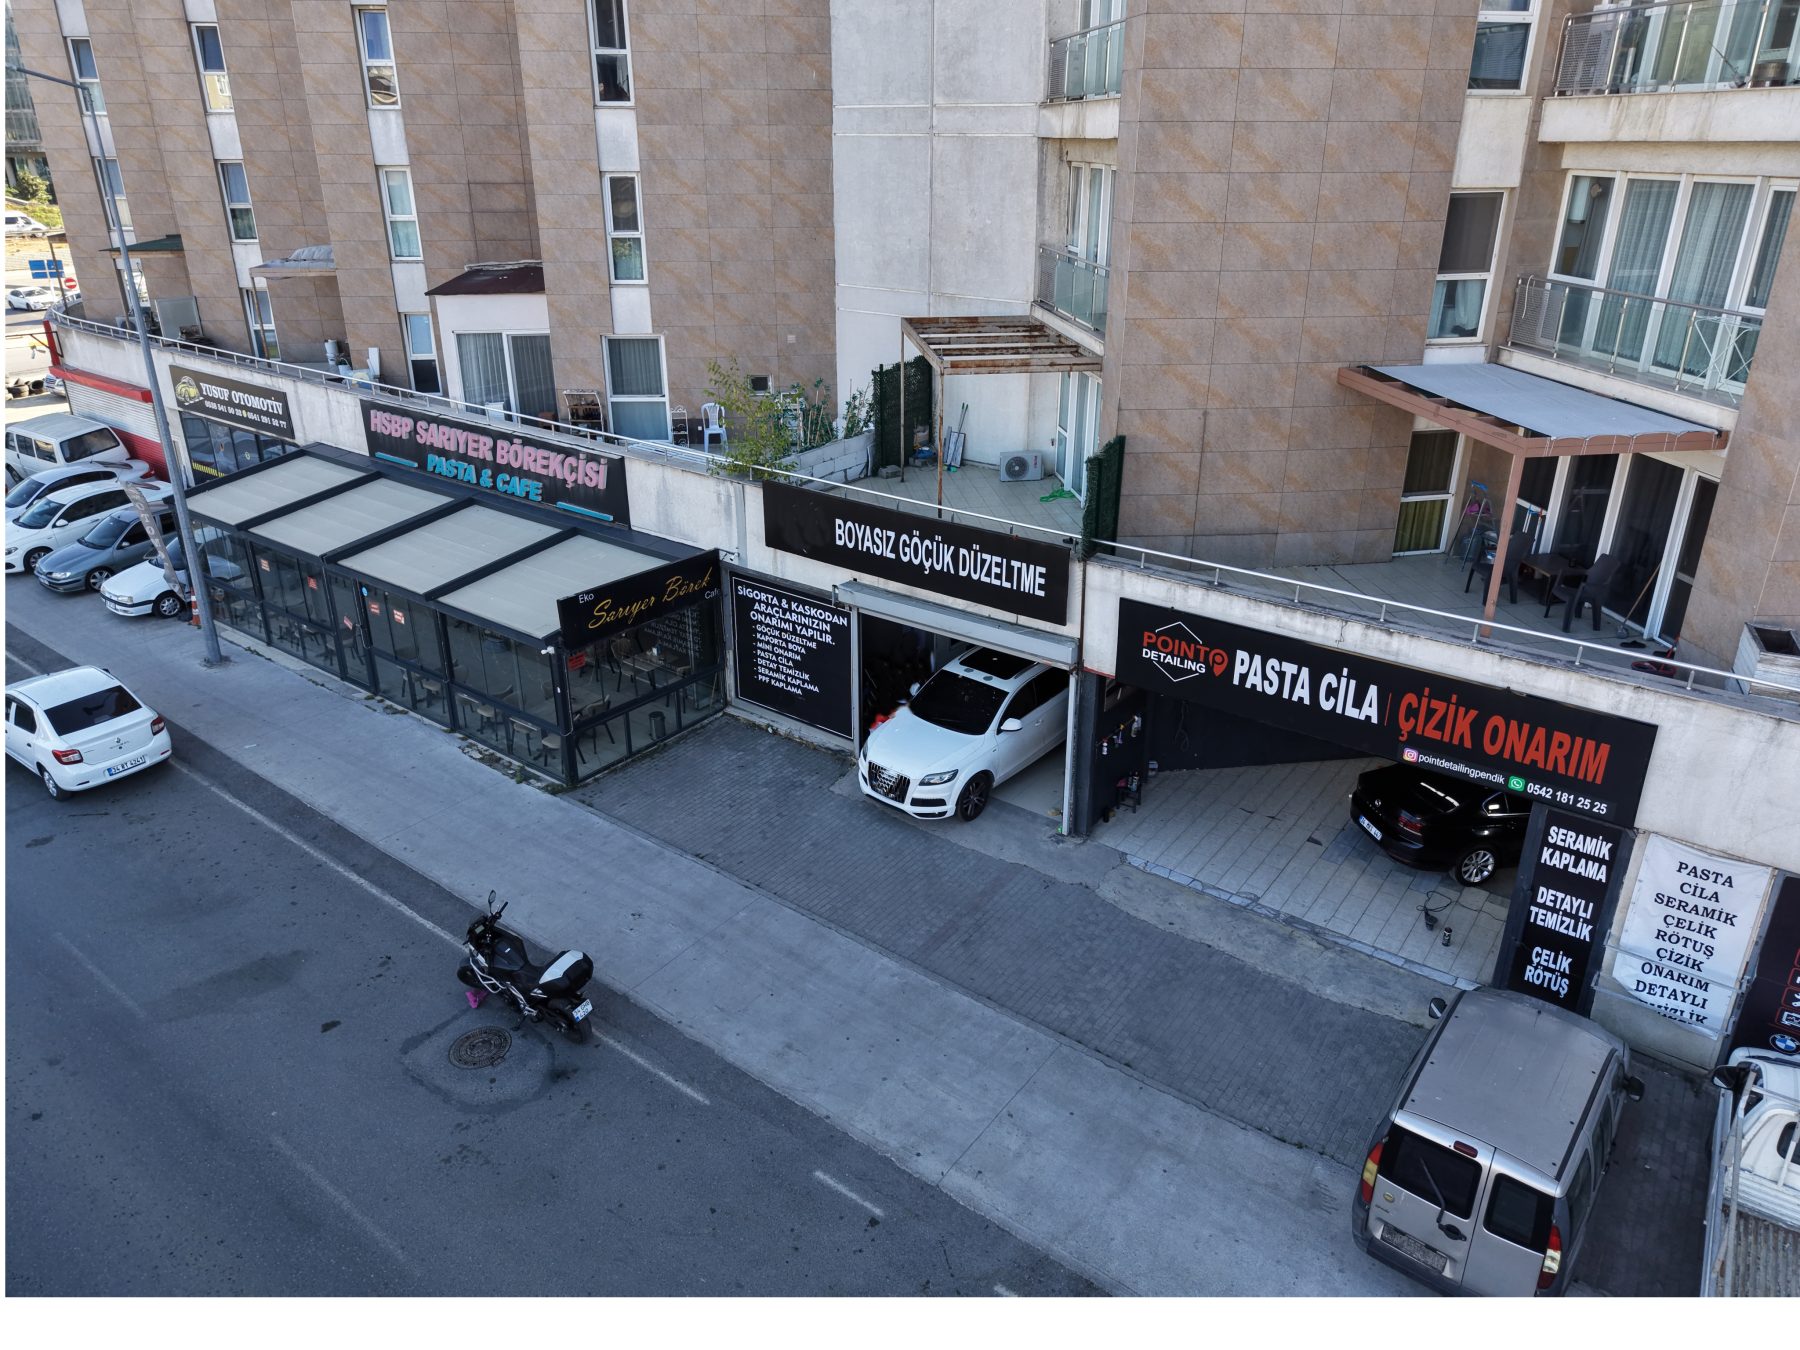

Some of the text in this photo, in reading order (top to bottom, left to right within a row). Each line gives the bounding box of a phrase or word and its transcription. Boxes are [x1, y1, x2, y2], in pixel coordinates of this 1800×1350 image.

[200, 382, 283, 415] YUSUF OTOMOTİV
[370, 409, 608, 490] HSBP SARIYER BÖREKÇİSİ
[427, 453, 543, 501] PASTA & CAFE
[835, 518, 1047, 597] BOYASIZ GÖÇÜK DÜZELTME
[579, 592, 595, 604] Eko
[662, 566, 713, 602] Börek
[737, 585, 848, 627] SİGORTA & KASKODAN
[753, 602, 831, 633] ARAÇLARINIZIN
[750, 611, 836, 646] ONARIMI YAPILIR.
[756, 624, 817, 649] GÖÇÜK DÜZELTME
[756, 633, 806, 655] KAPORTA BOYA
[756, 641, 801, 661] MİNİ ONARIM
[757, 650, 794, 667] PASTA CİLA
[1142, 648, 1206, 674] DETAILING
[757, 658, 810, 681] DETAY TEMİZLİK
[757, 666, 820, 693] SERAMİK KAPLAMA
[771, 680, 803, 695] KAPLAMA
[1232, 649, 1611, 785] PASTA CİLA ÇİZİK ONARIM
[1418, 754, 1505, 785] pointdetailingpendik
[1527, 782, 1608, 815] 0542 181 25 25
[1547, 825, 1613, 861] SERAMİK
[1540, 846, 1607, 883] KAPLAMA
[1676, 861, 1734, 888] PASTA
[1536, 886, 1594, 920] DETAYLI
[1679, 882, 1720, 903] CİLA
[1529, 905, 1593, 942] TEMİZLİK
[1654, 892, 1739, 927] SERAMİK
[1663, 914, 1718, 940] ÇELİK
[1654, 929, 1715, 960] RÖTUŞ
[1656, 947, 1705, 973] ÇİZİK
[1531, 946, 1573, 975] ÇELİK
[1524, 965, 1570, 999] RÖTÜŞ
[1641, 962, 1710, 993] ONARIM
[1634, 979, 1709, 1010] DETAYLI
